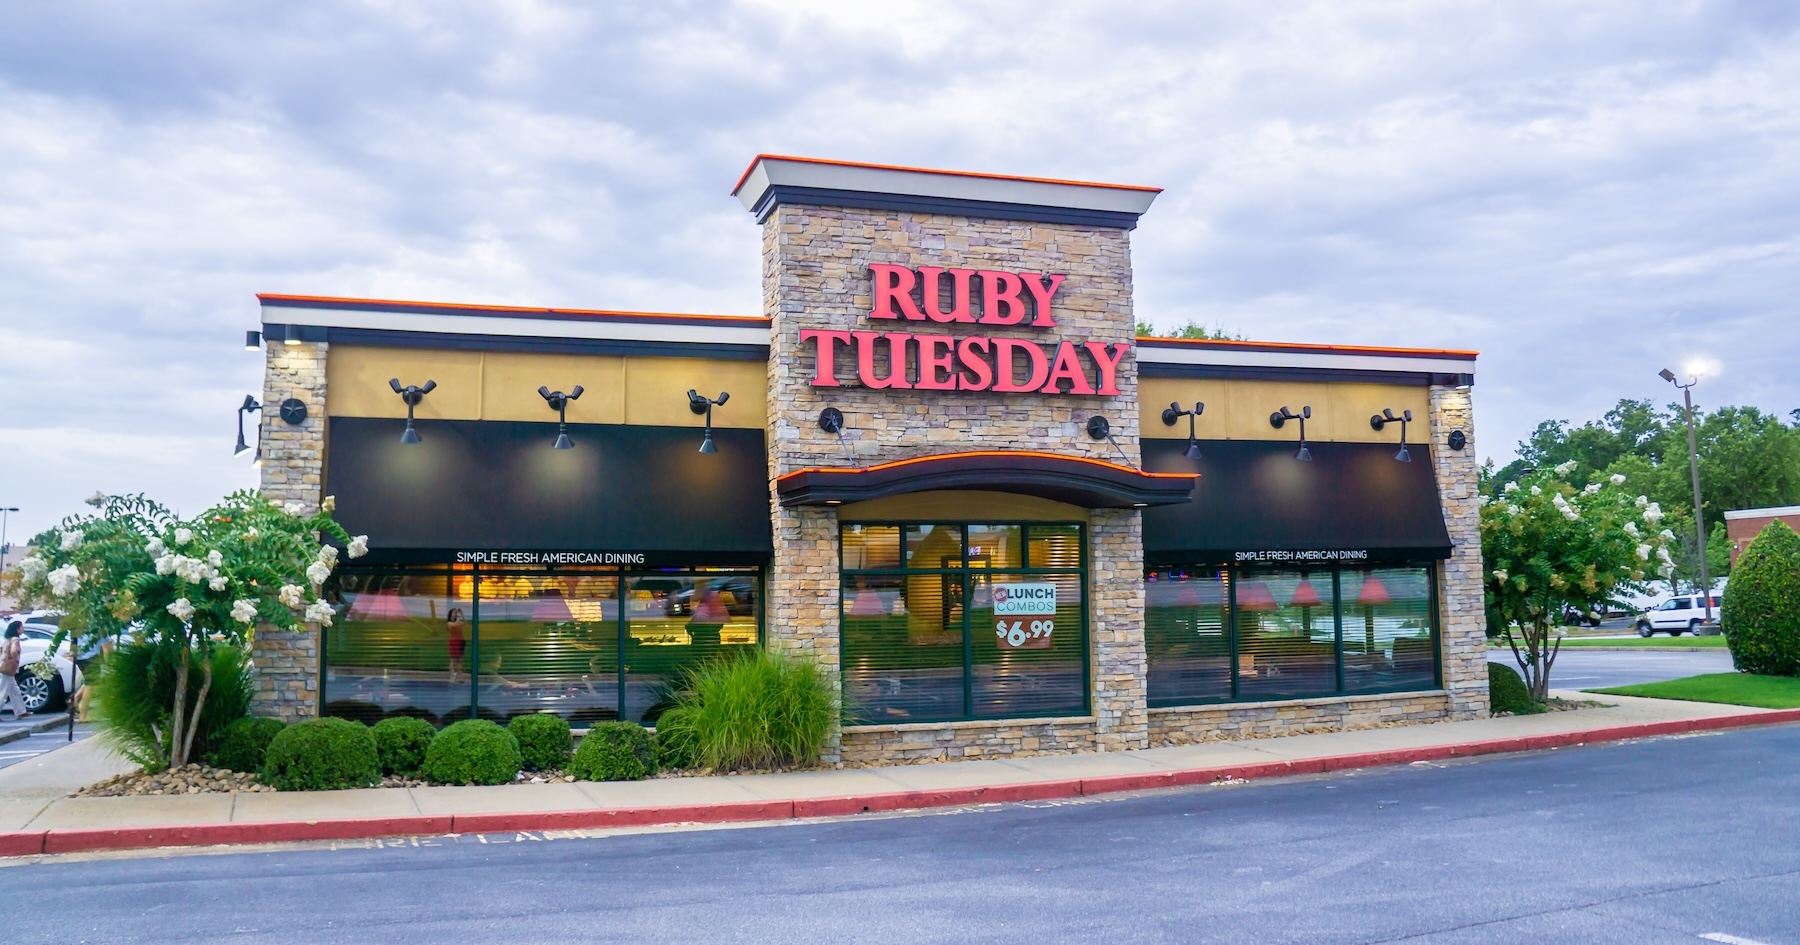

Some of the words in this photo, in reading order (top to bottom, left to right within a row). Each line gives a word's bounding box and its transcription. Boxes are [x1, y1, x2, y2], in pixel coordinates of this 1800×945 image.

[868, 263, 1067, 328] RUBY
[798, 329, 1131, 397] TUESDAY
[456, 551, 498, 563] SIMPLE
[500, 552, 539, 563] FRESH
[541, 552, 602, 564] AMERICAN
[605, 553, 645, 564] DINING
[1235, 551, 1266, 561] SIMPLE
[1266, 551, 1294, 560] FRESH
[1295, 550, 1339, 560] AMERICAN
[1340, 549, 1368, 560] DINING
[1007, 588, 1054, 599] LUNCH
[996, 601, 1054, 612] COMBOS
[996, 620, 1054, 647] $6.99
